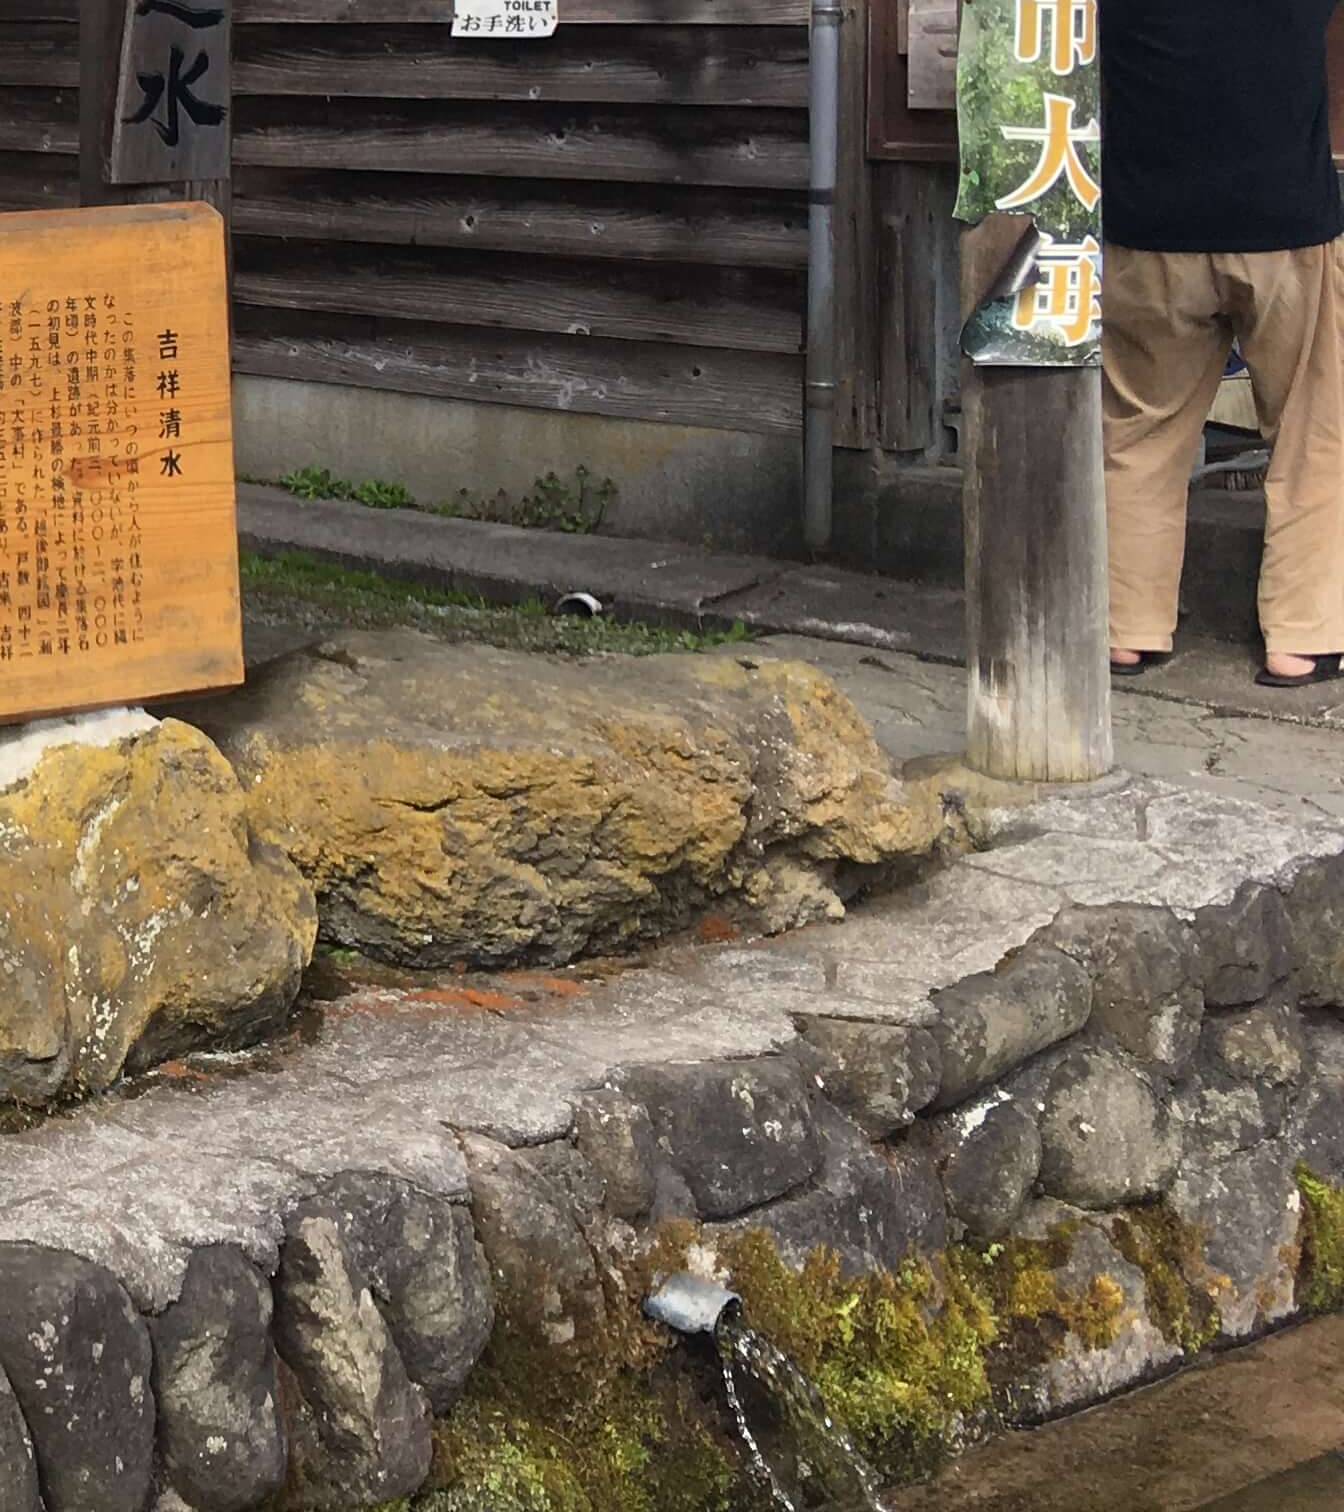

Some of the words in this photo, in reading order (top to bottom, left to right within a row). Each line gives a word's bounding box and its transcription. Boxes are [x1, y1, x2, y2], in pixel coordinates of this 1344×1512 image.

[504, 0, 551, 11] TOILET
[461, 14, 548, 32] お手洗い
[157, 329, 182, 477] 吉祥清水
